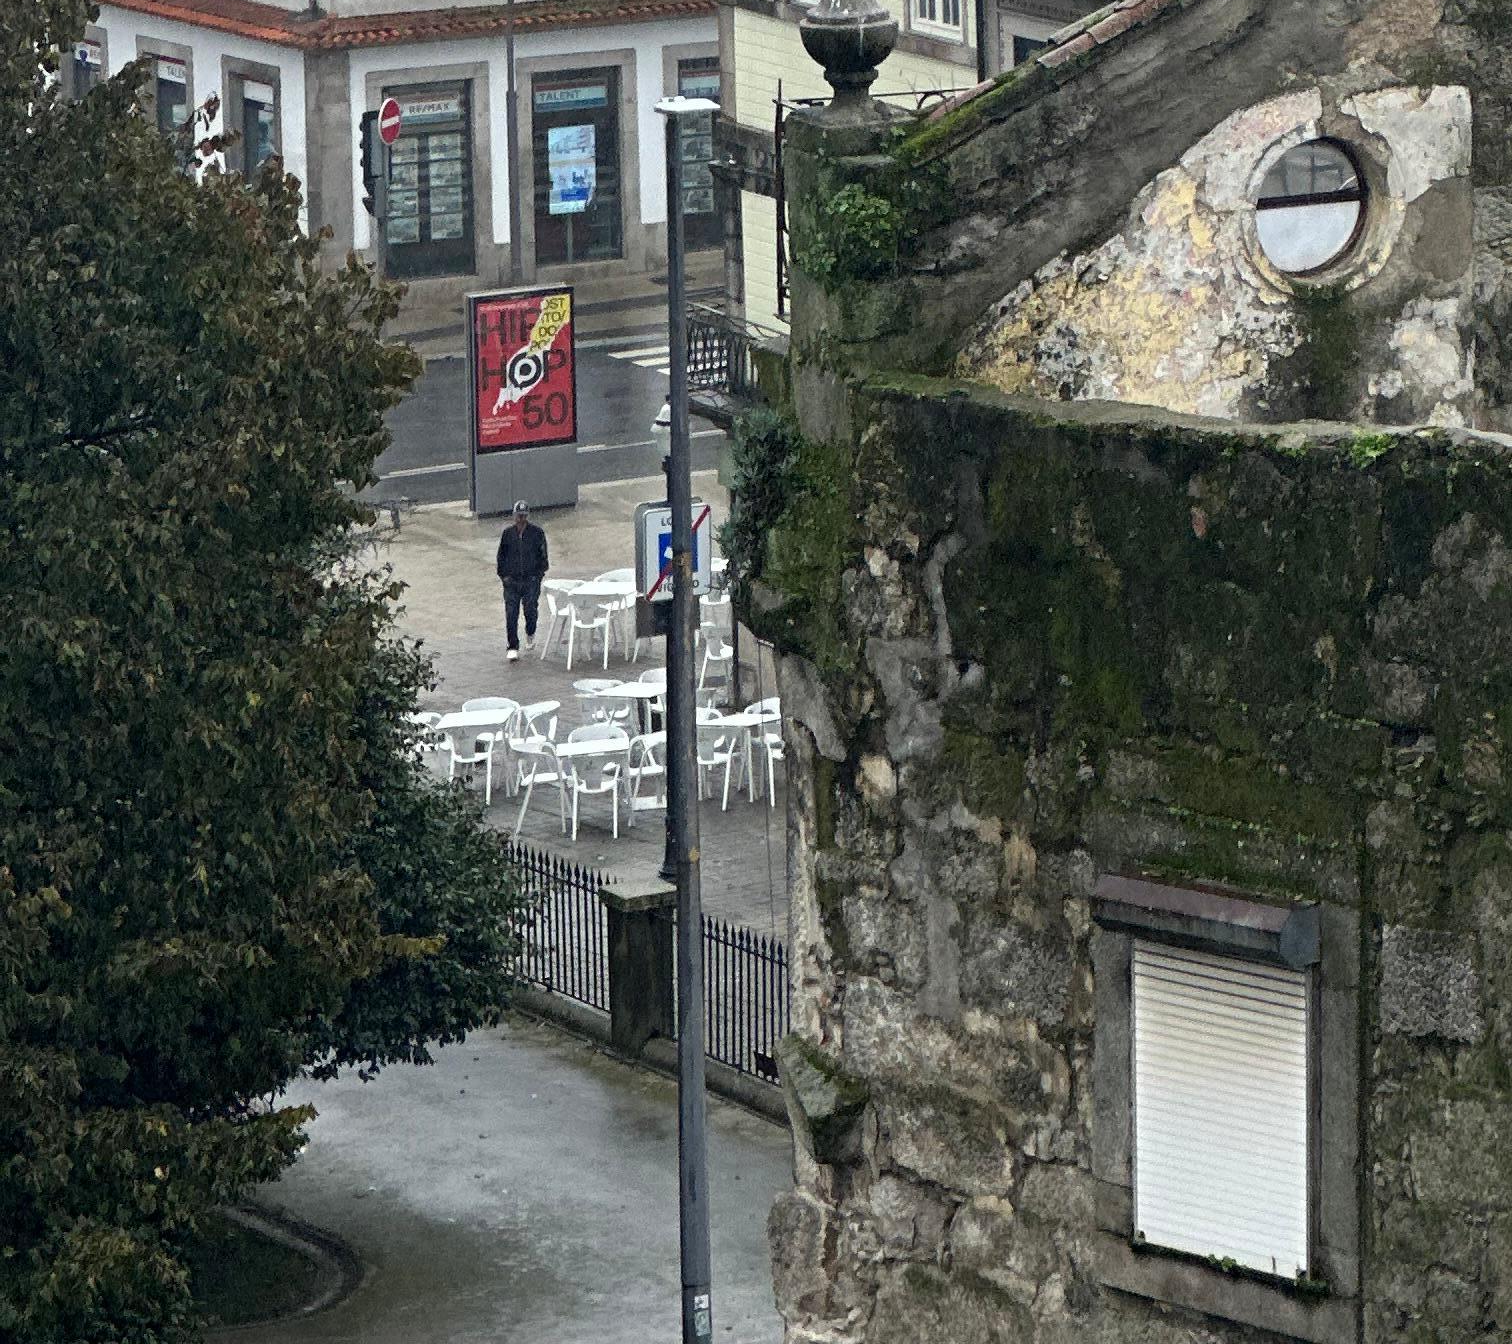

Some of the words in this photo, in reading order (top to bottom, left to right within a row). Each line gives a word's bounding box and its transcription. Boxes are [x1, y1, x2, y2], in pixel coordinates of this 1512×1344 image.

[539, 89, 582, 103] TALENT
[481, 348, 567, 392] HOP
[523, 392, 569, 430] 50
